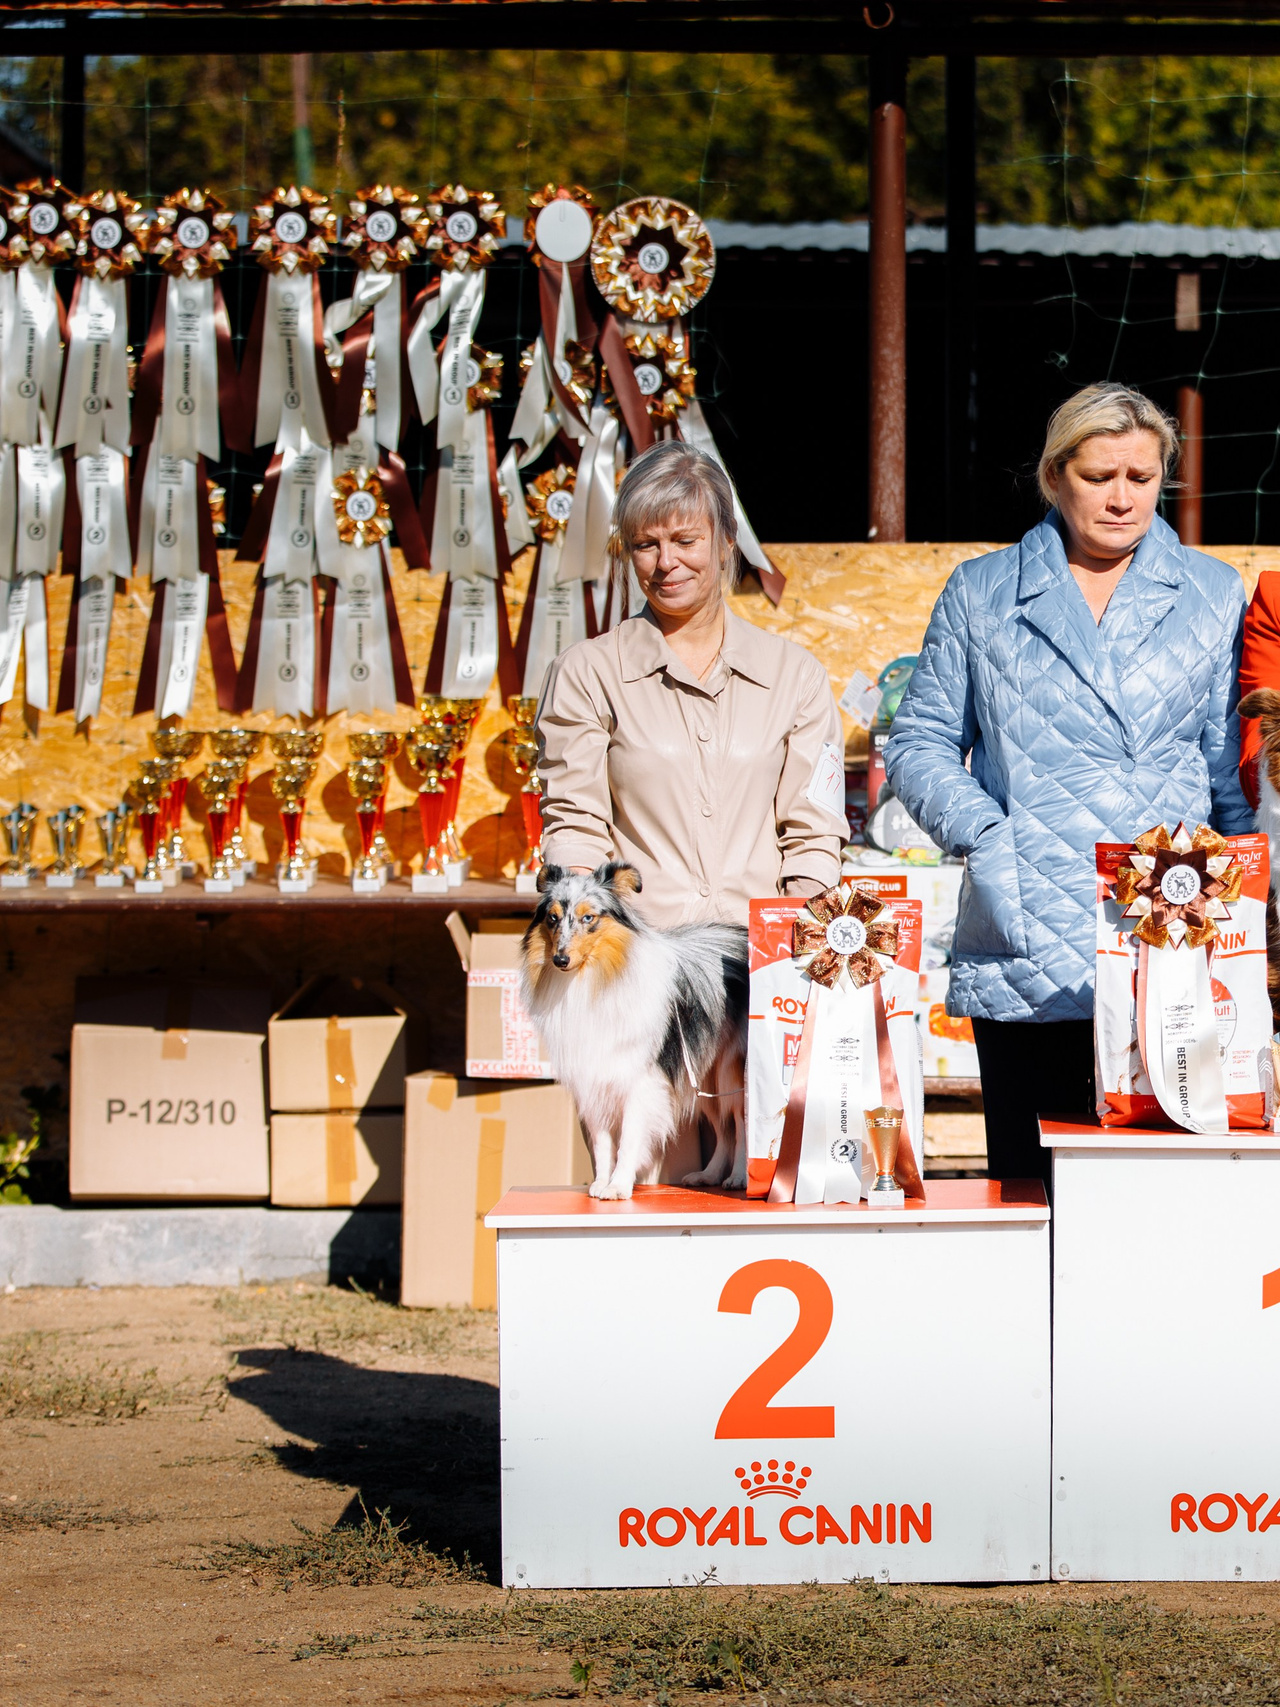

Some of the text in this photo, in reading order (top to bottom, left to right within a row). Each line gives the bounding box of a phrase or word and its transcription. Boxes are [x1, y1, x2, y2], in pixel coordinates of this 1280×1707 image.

[1215, 930, 1246, 950] NIN
[772, 996, 808, 1015] ROY
[1215, 1004, 1231, 1016] ult
[1177, 1047, 1191, 1118] BEST IN GROUP
[106, 1099, 236, 1125] P-12/310
[839, 1145, 849, 1157] 2
[714, 1258, 835, 1440] 2
[618, 1502, 932, 1547] ROYAL CANIN
